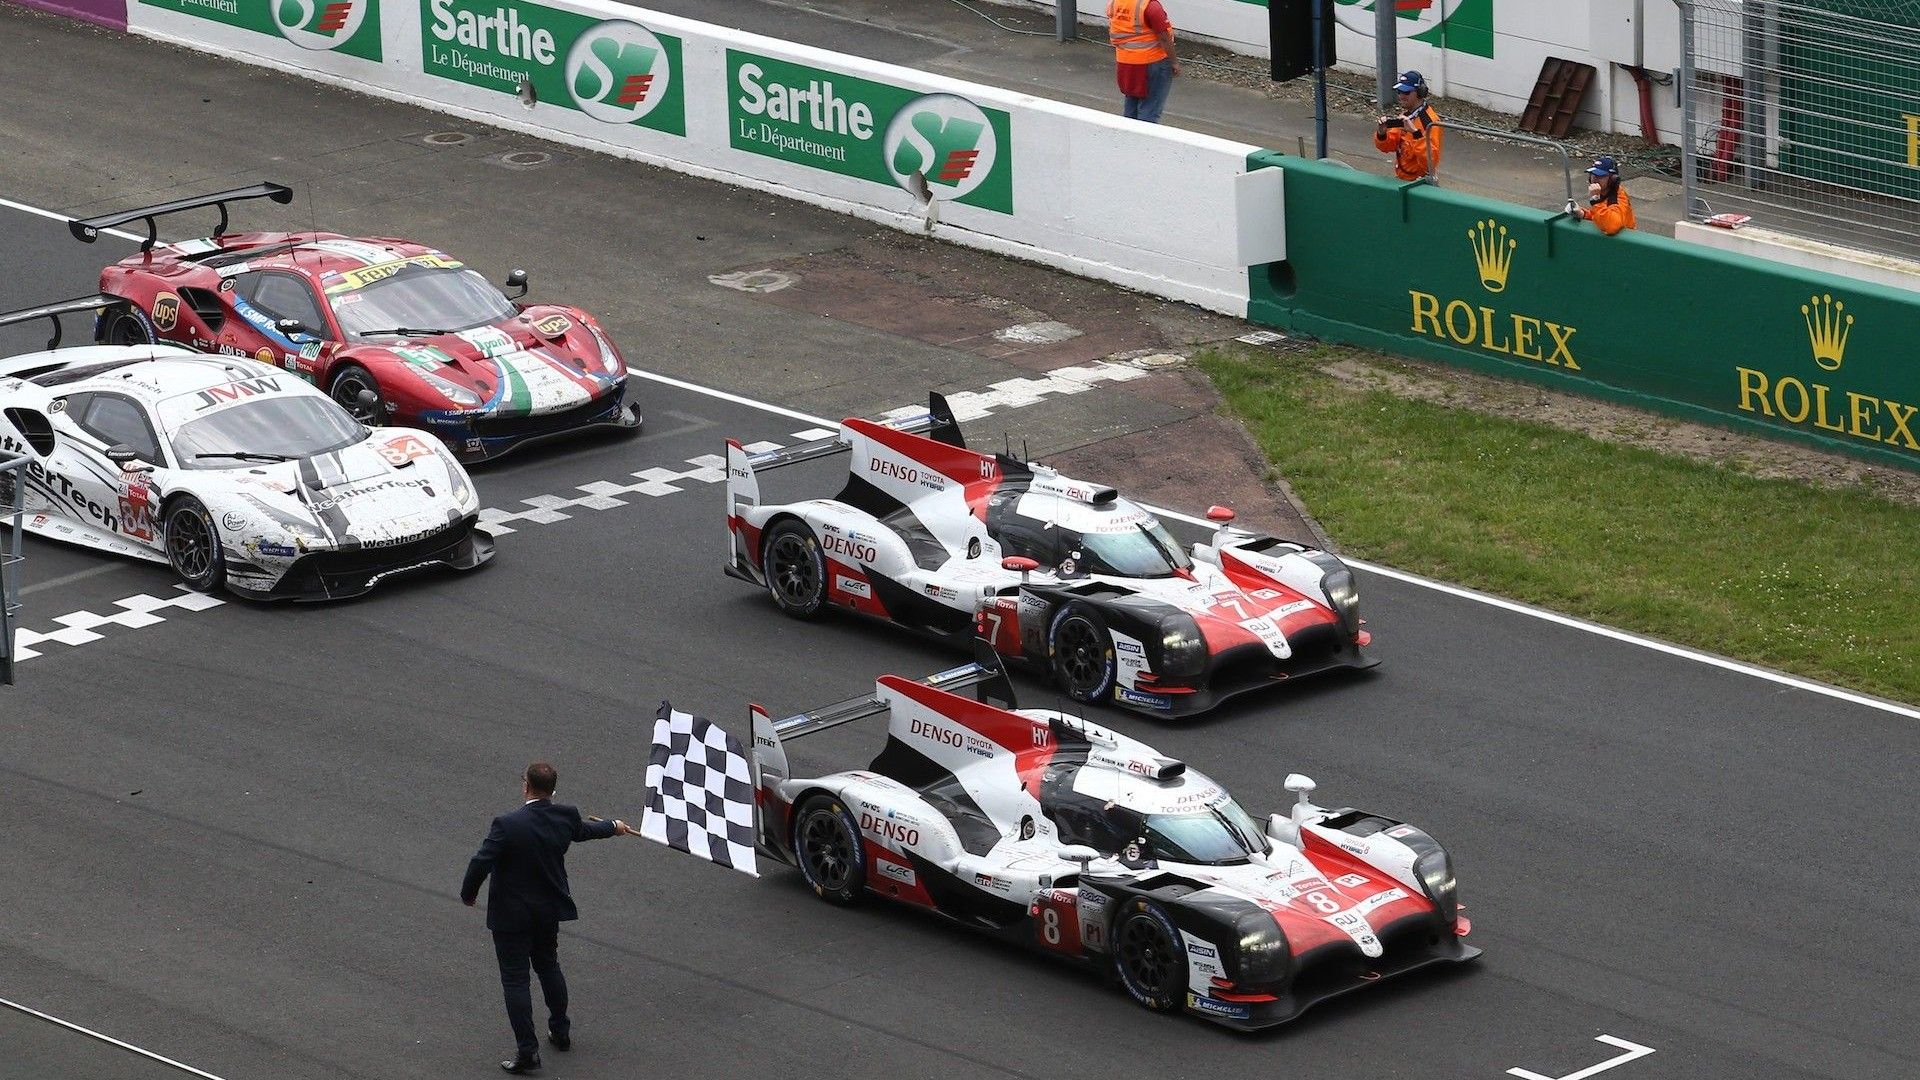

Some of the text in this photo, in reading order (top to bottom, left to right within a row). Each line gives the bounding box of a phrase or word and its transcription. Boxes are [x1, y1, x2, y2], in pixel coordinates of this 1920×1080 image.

[430, 0, 556, 66] Sarthe
[432, 45, 531, 84] Le Département
[738, 62, 874, 140] Sarthe
[739, 118, 846, 162] Le Département
[155, 302, 176, 324] ups
[538, 314, 571, 333] ups
[1408, 289, 1581, 371] ROLEX
[218, 344, 247, 358] ADLER
[296, 361, 314, 372] TOTAL
[195, 377, 281, 411] JMW
[1735, 365, 1920, 451] ROLEX
[381, 438, 432, 464] 84
[870, 457, 917, 483] DENSO
[920, 470, 945, 485] TOYOTA
[980, 460, 995, 479] HY
[128, 488, 147, 502] TOTAL
[920, 479, 945, 492] HYBRID
[1066, 487, 1091, 501] ZENT
[306, 477, 431, 514] WeatherTech
[120, 501, 153, 534] 84
[226, 513, 236, 521] AJ
[363, 521, 448, 549] WeatherTech
[823, 534, 876, 563] DENSO
[925, 587, 939, 597] GR
[1220, 601, 1251, 621] 7
[986, 612, 1001, 646] 7
[1118, 643, 1140, 653] AISIN
[1128, 694, 1165, 705] MICHELIN
[911, 718, 963, 748] DENSO
[967, 735, 993, 750] TOYOTA
[1032, 726, 1049, 748] HY
[967, 746, 994, 759] HYBRID
[1127, 759, 1155, 776] ZENT
[1177, 787, 1216, 804] DENSO
[1160, 805, 1207, 813] TOYOTA
[860, 813, 919, 846] DENSO
[1364, 846, 1370, 855] 8
[975, 877, 991, 887] GR
[1340, 875, 1365, 885] P1
[1053, 892, 1075, 905] TOTA
[1306, 891, 1341, 913] 8
[1043, 908, 1061, 945] 8
[1189, 945, 1214, 957] AISIN
[1203, 1002, 1244, 1014] MICHELIN
